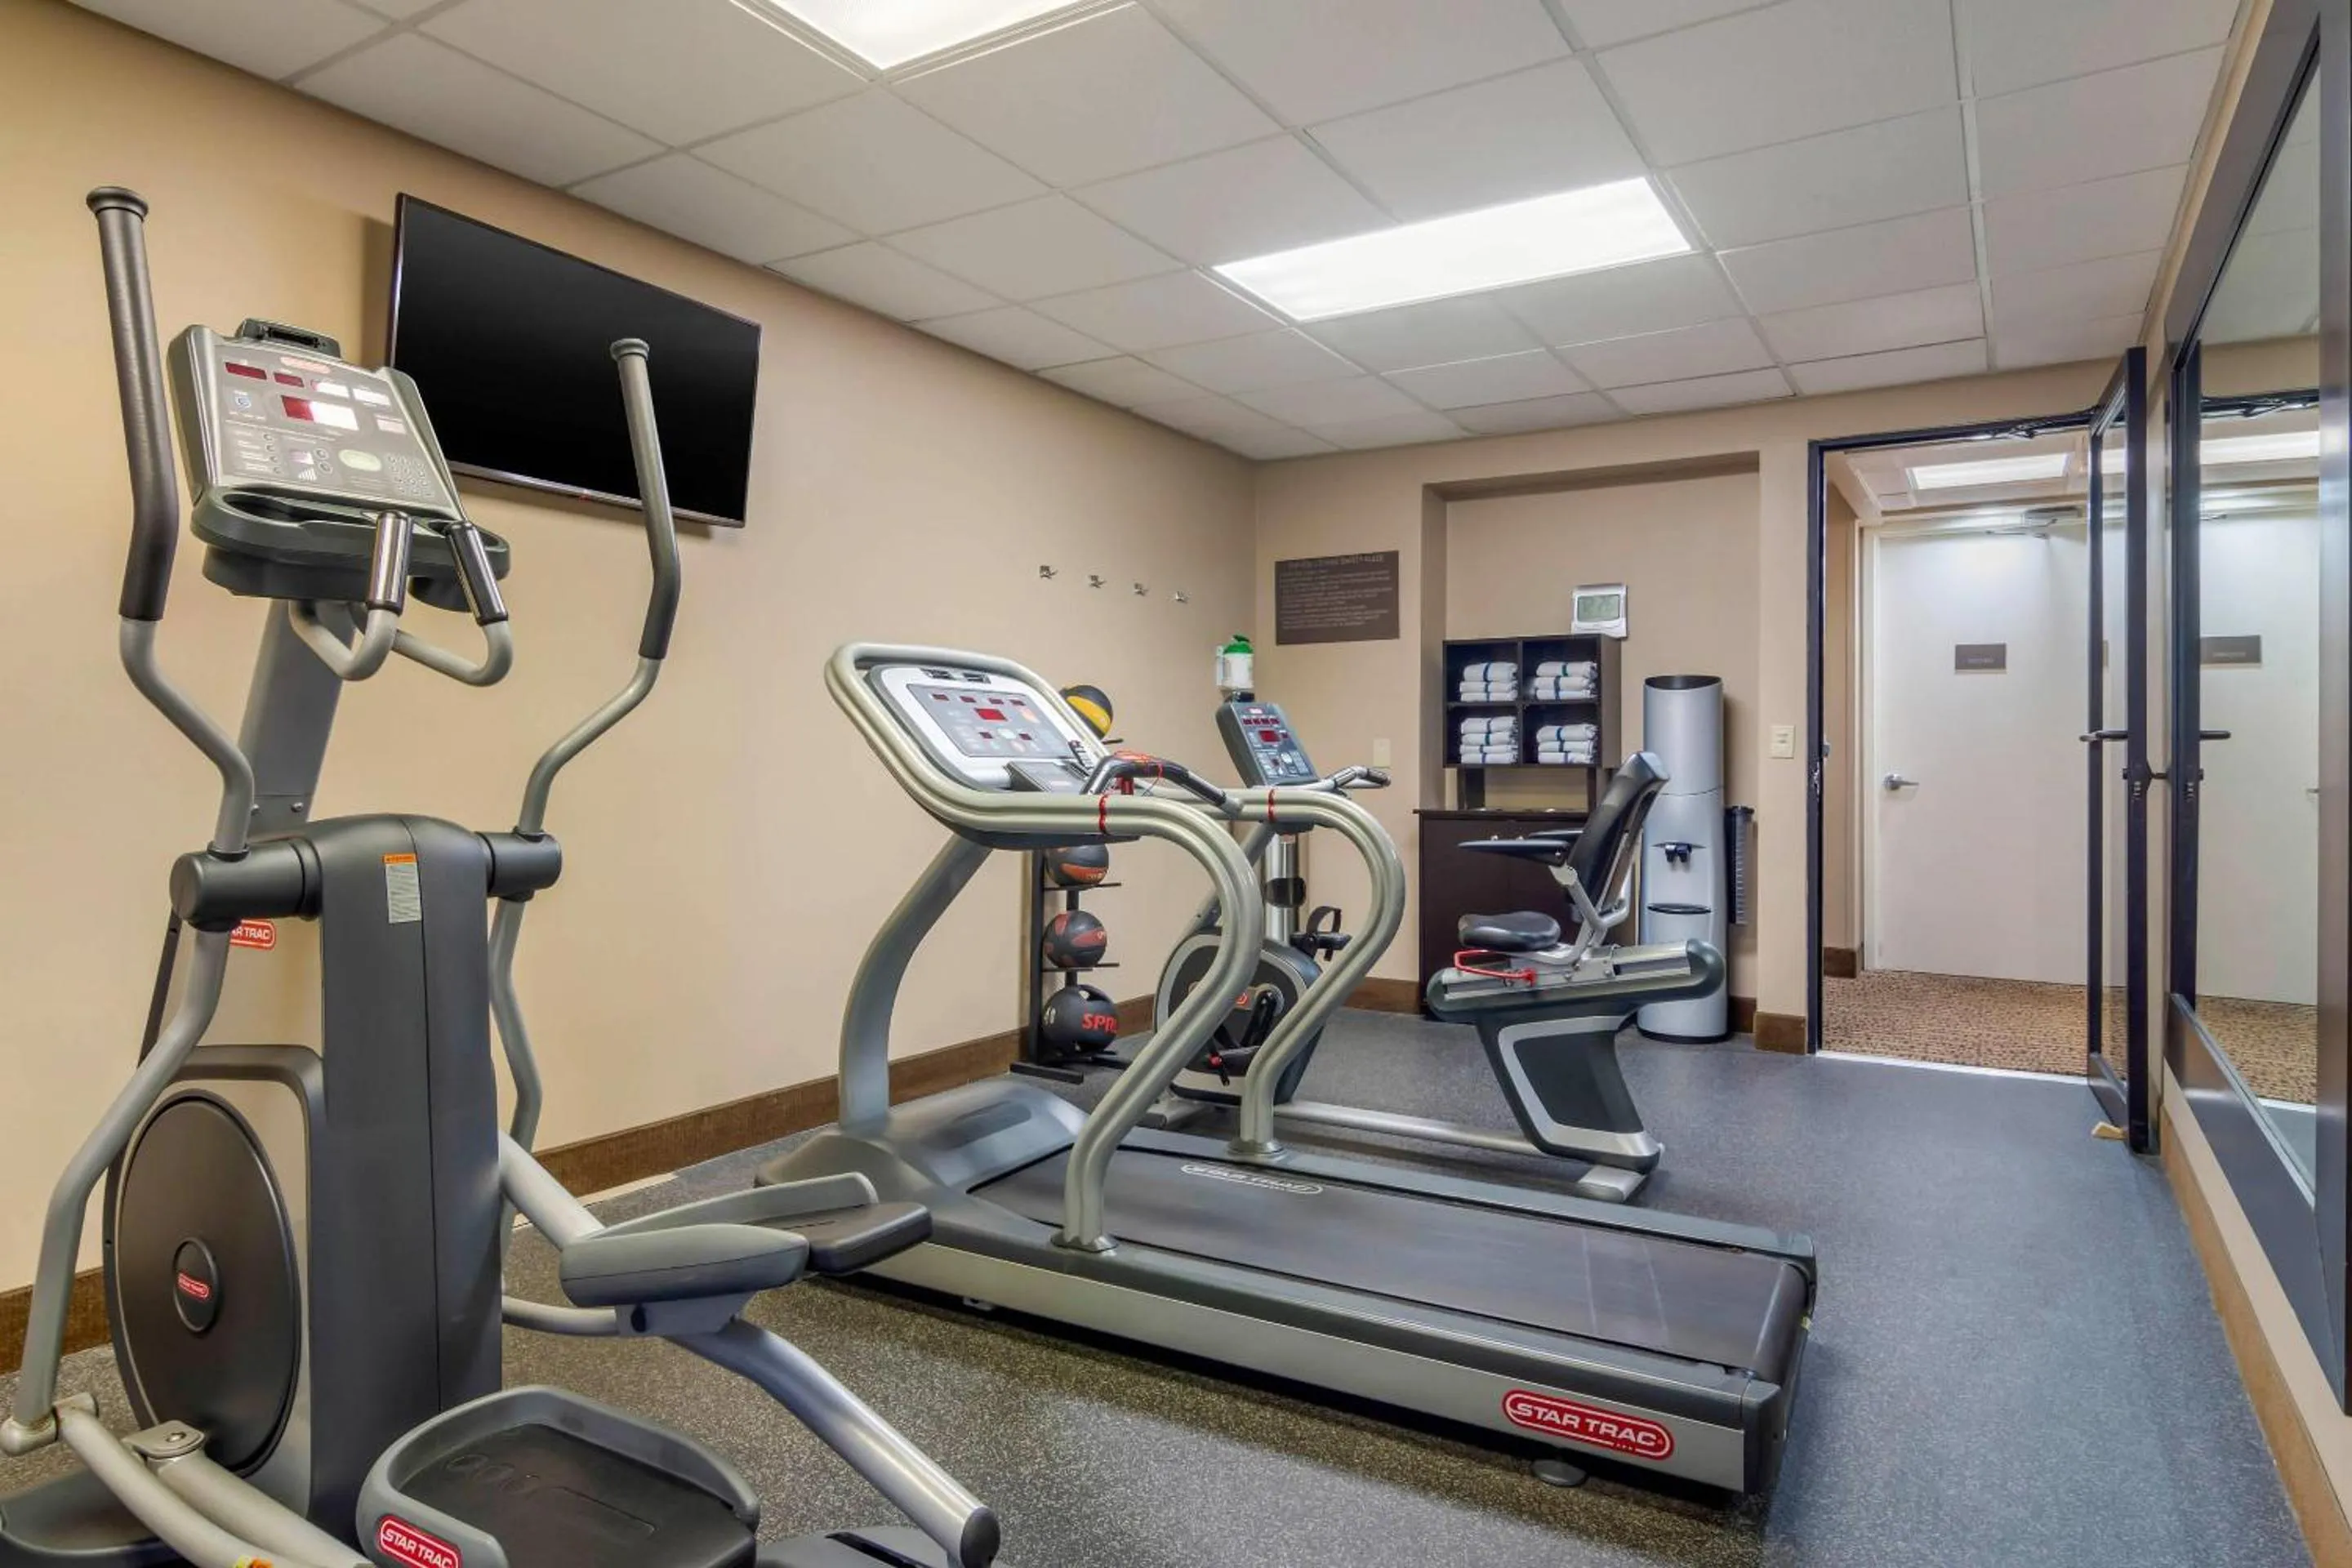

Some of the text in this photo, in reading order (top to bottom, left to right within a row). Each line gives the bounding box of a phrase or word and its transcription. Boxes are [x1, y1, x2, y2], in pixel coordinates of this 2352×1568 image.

[1512, 1403, 1657, 1446] STAR TRAC
[383, 1528, 453, 1568] STAR TRAC
